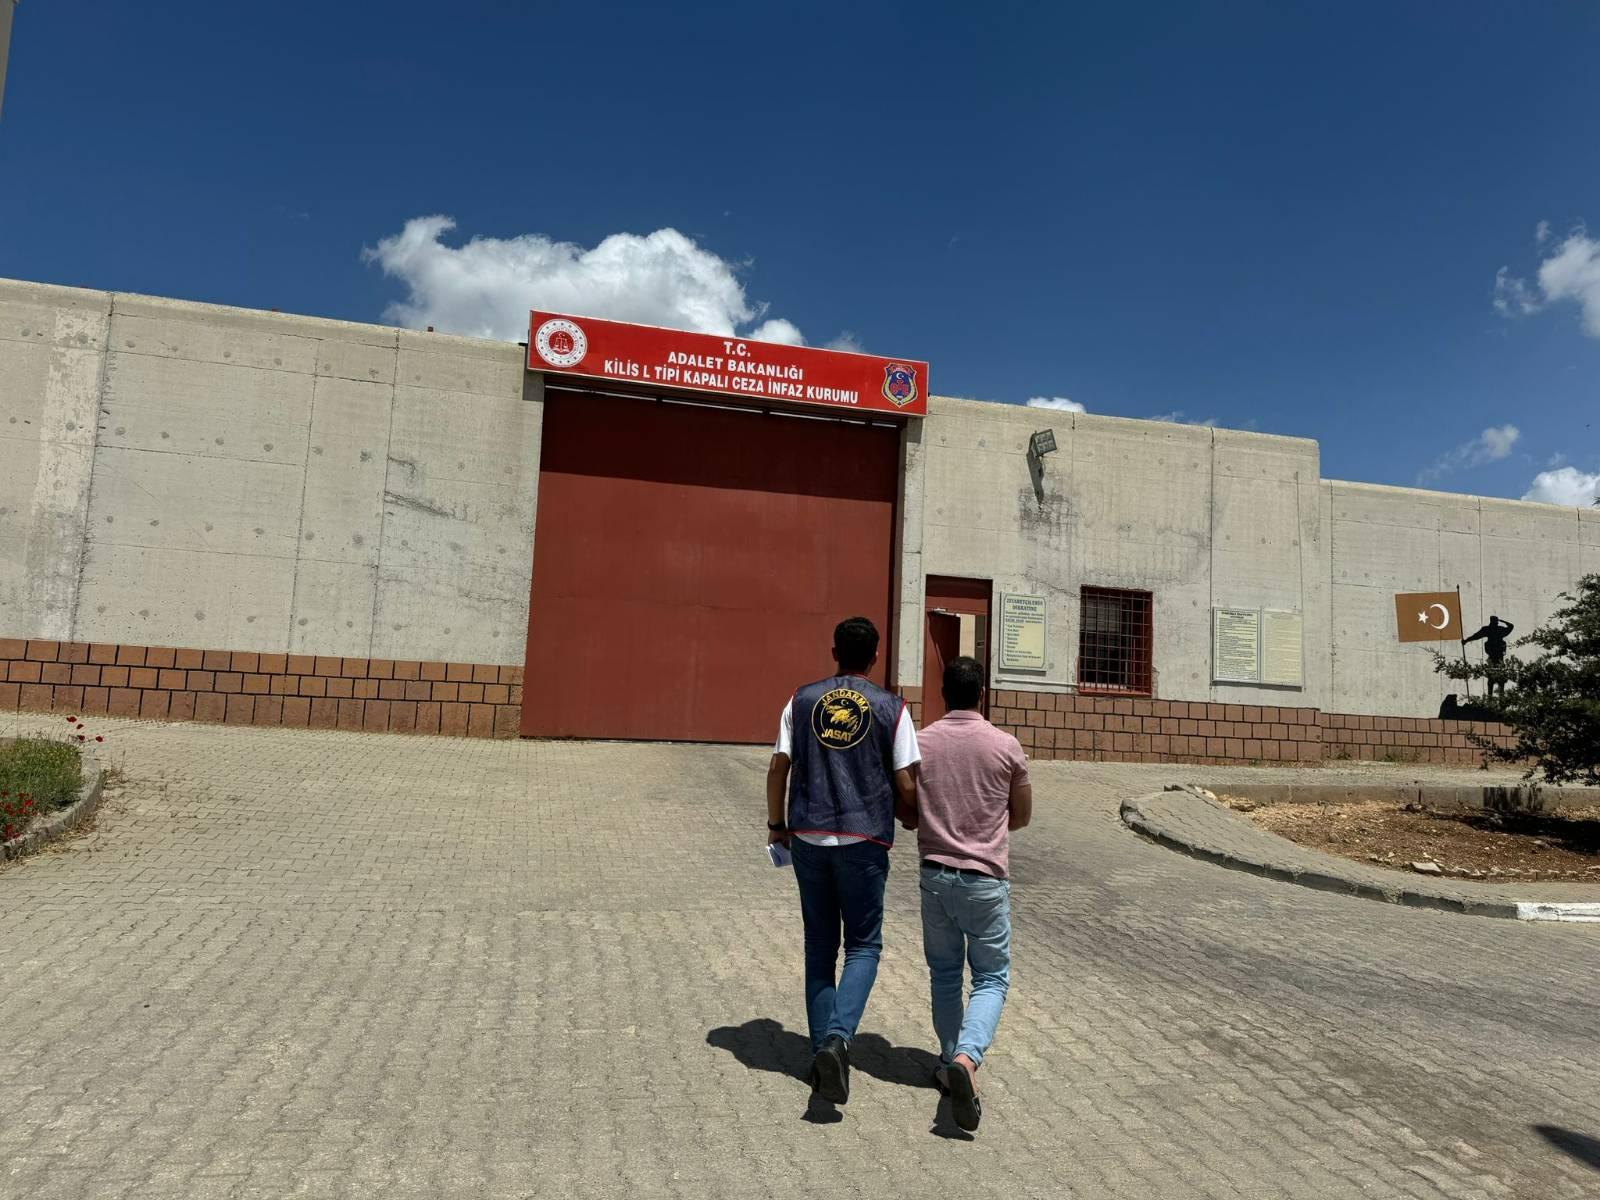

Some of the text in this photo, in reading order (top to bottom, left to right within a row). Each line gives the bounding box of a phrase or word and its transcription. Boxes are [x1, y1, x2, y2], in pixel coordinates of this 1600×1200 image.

[723, 341, 751, 357] T.C.
[667, 351, 804, 380] ADALET BAKANLIĞI
[604, 358, 859, 404] KİLİS L TİPİ KAPALI CEZA İNFAZ KURUMU
[822, 689, 869, 713] JANDARMA
[821, 728, 853, 742] JASAT
